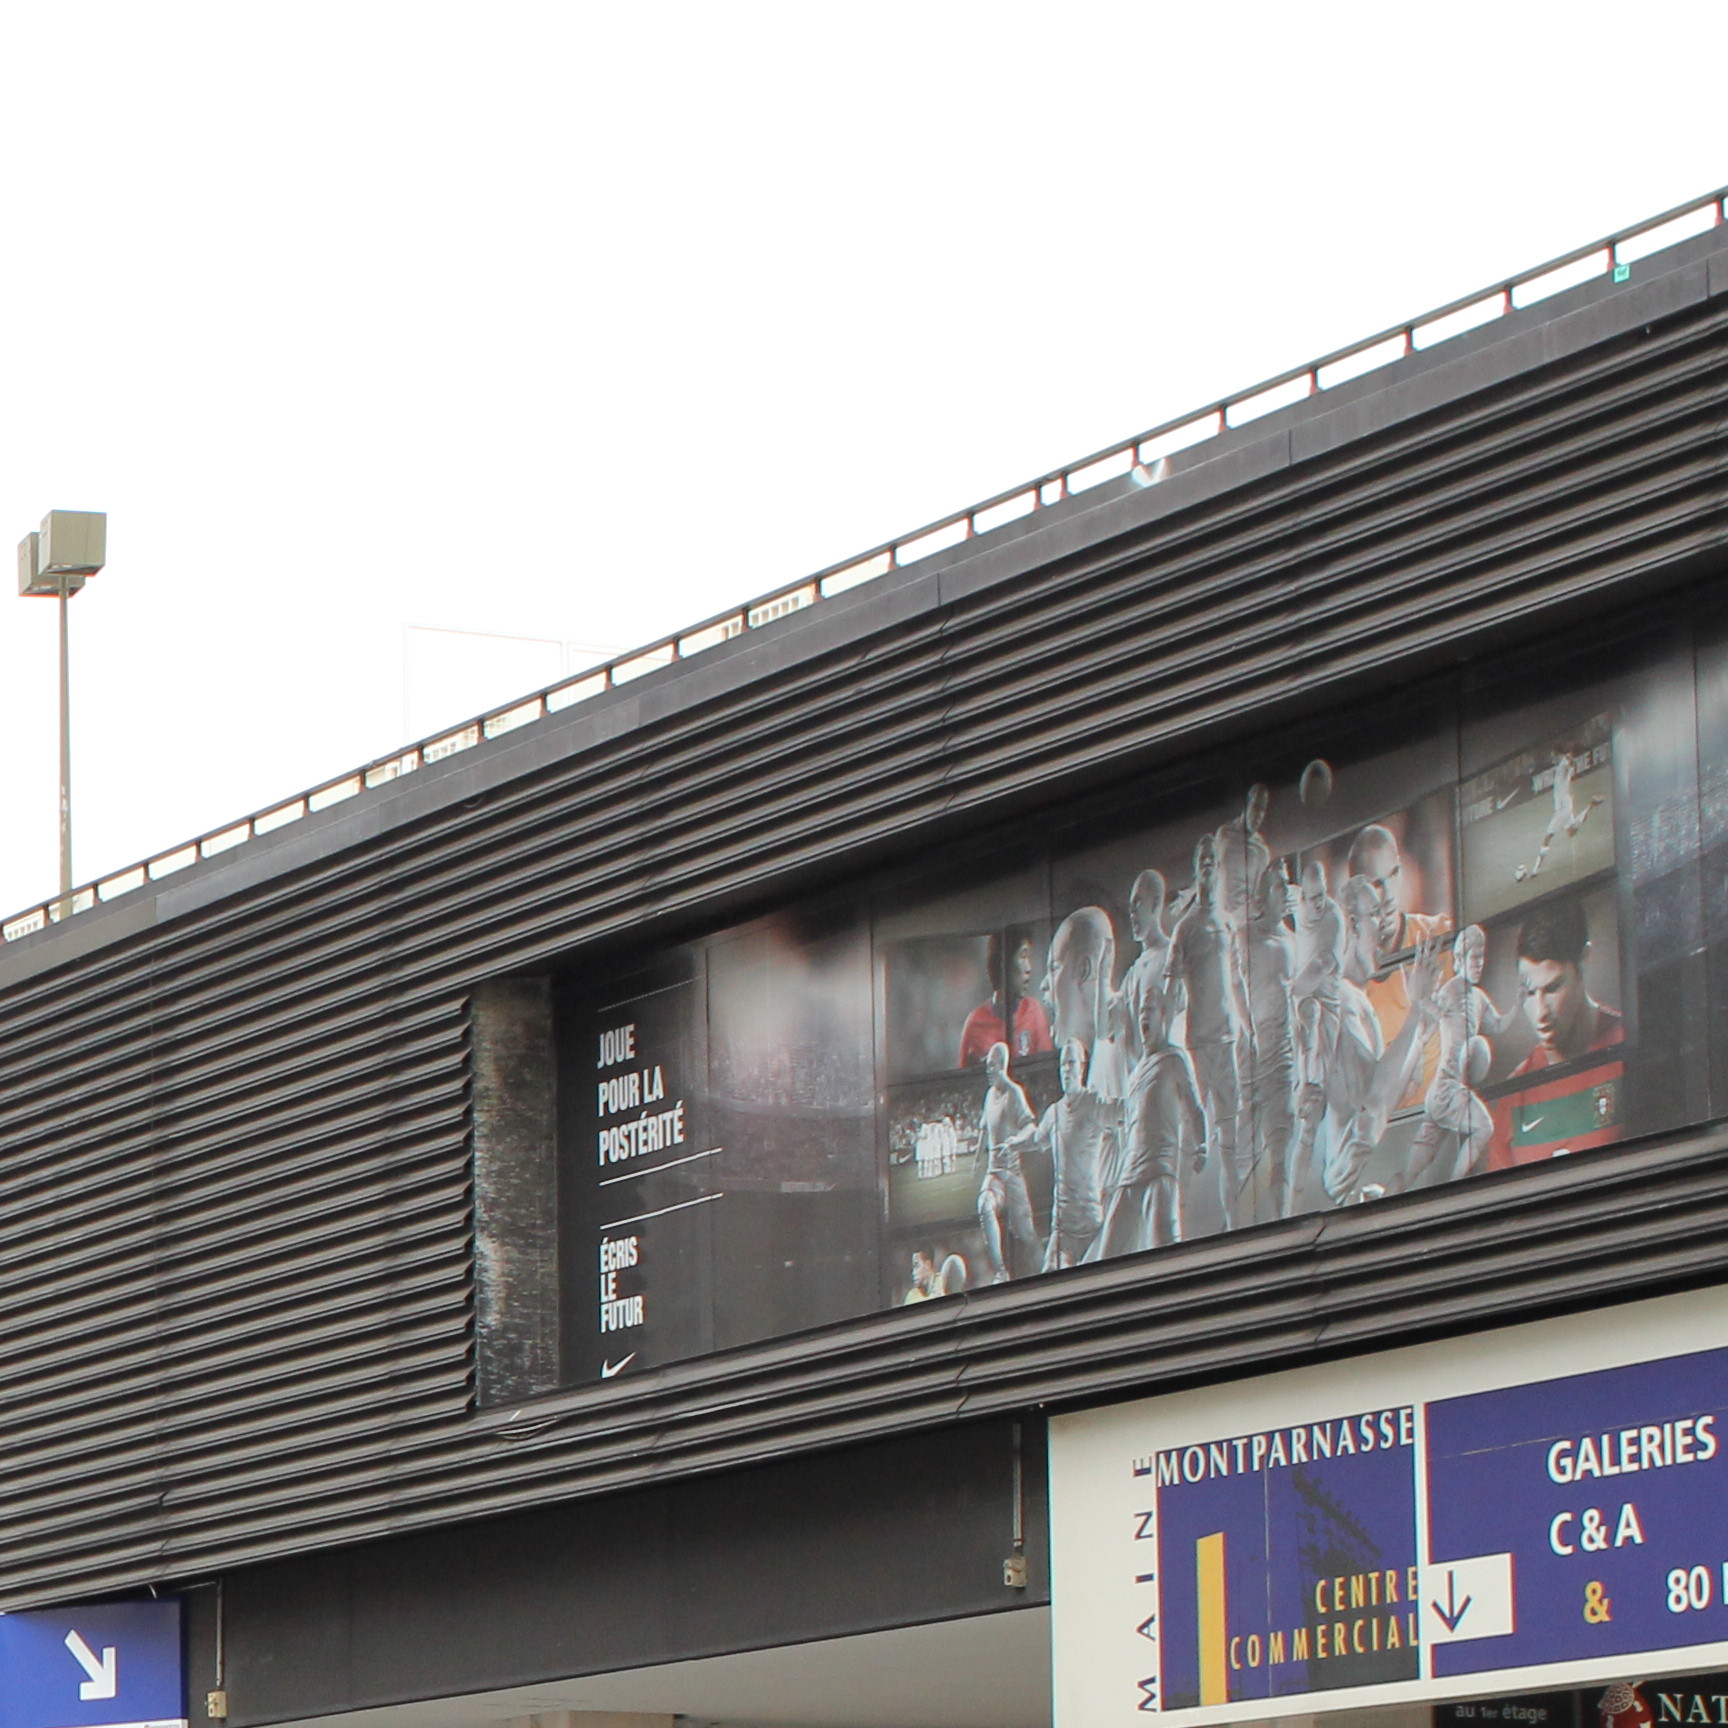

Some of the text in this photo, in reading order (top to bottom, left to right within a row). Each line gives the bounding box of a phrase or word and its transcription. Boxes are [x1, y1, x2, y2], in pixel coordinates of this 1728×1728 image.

[597, 1023, 636, 1070] JOUE
[598, 1065, 665, 1118] POUR LA
[598, 1100, 685, 1166] POSTÉRITÉ
[599, 1237, 639, 1274] ÉCRIS
[599, 1272, 618, 1303] LE
[600, 1295, 645, 1334] FUTUR
[1157, 1407, 1416, 1488] MONTPARNASSE
[1547, 1414, 1719, 1485] GALERIES
[1132, 1456, 1159, 1713] MAINE
[1315, 1566, 1419, 1614] CENTRE
[1666, 1564, 1712, 1614] 80
[1229, 1612, 1420, 1671] COMMERCIAL
[1455, 1704, 1476, 1719] au
[1502, 1704, 1548, 1725] étage
